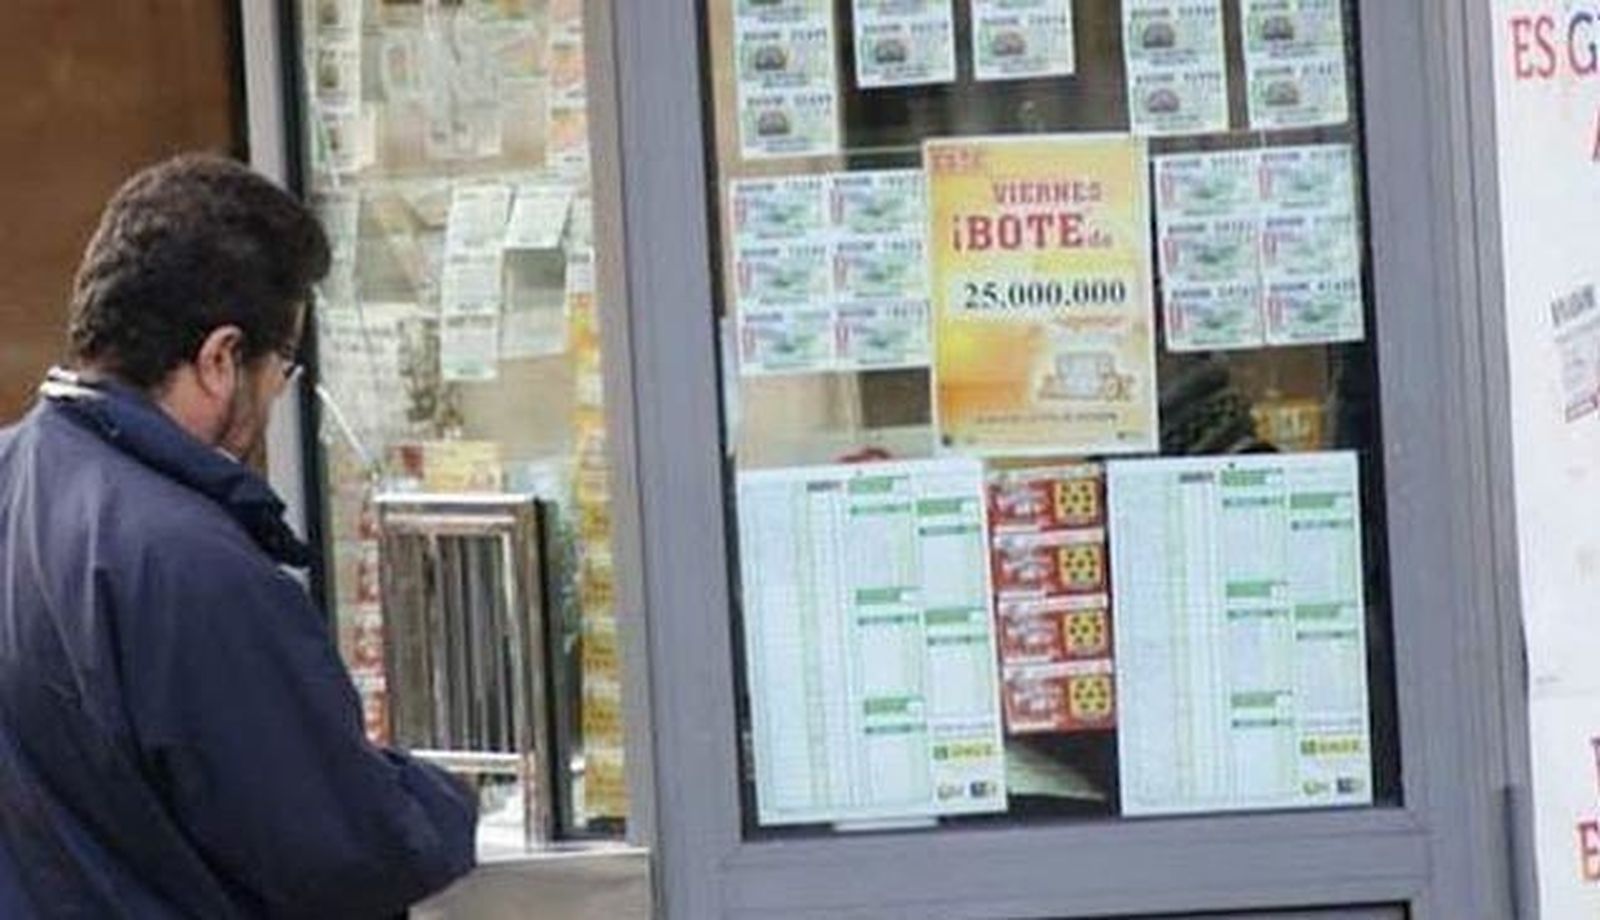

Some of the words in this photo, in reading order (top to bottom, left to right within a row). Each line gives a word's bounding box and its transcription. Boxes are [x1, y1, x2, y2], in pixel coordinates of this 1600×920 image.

[1510, 14, 1557, 79] ES
[992, 179, 1103, 203] VIERNES
[964, 278, 1127, 309] 25.000.000
